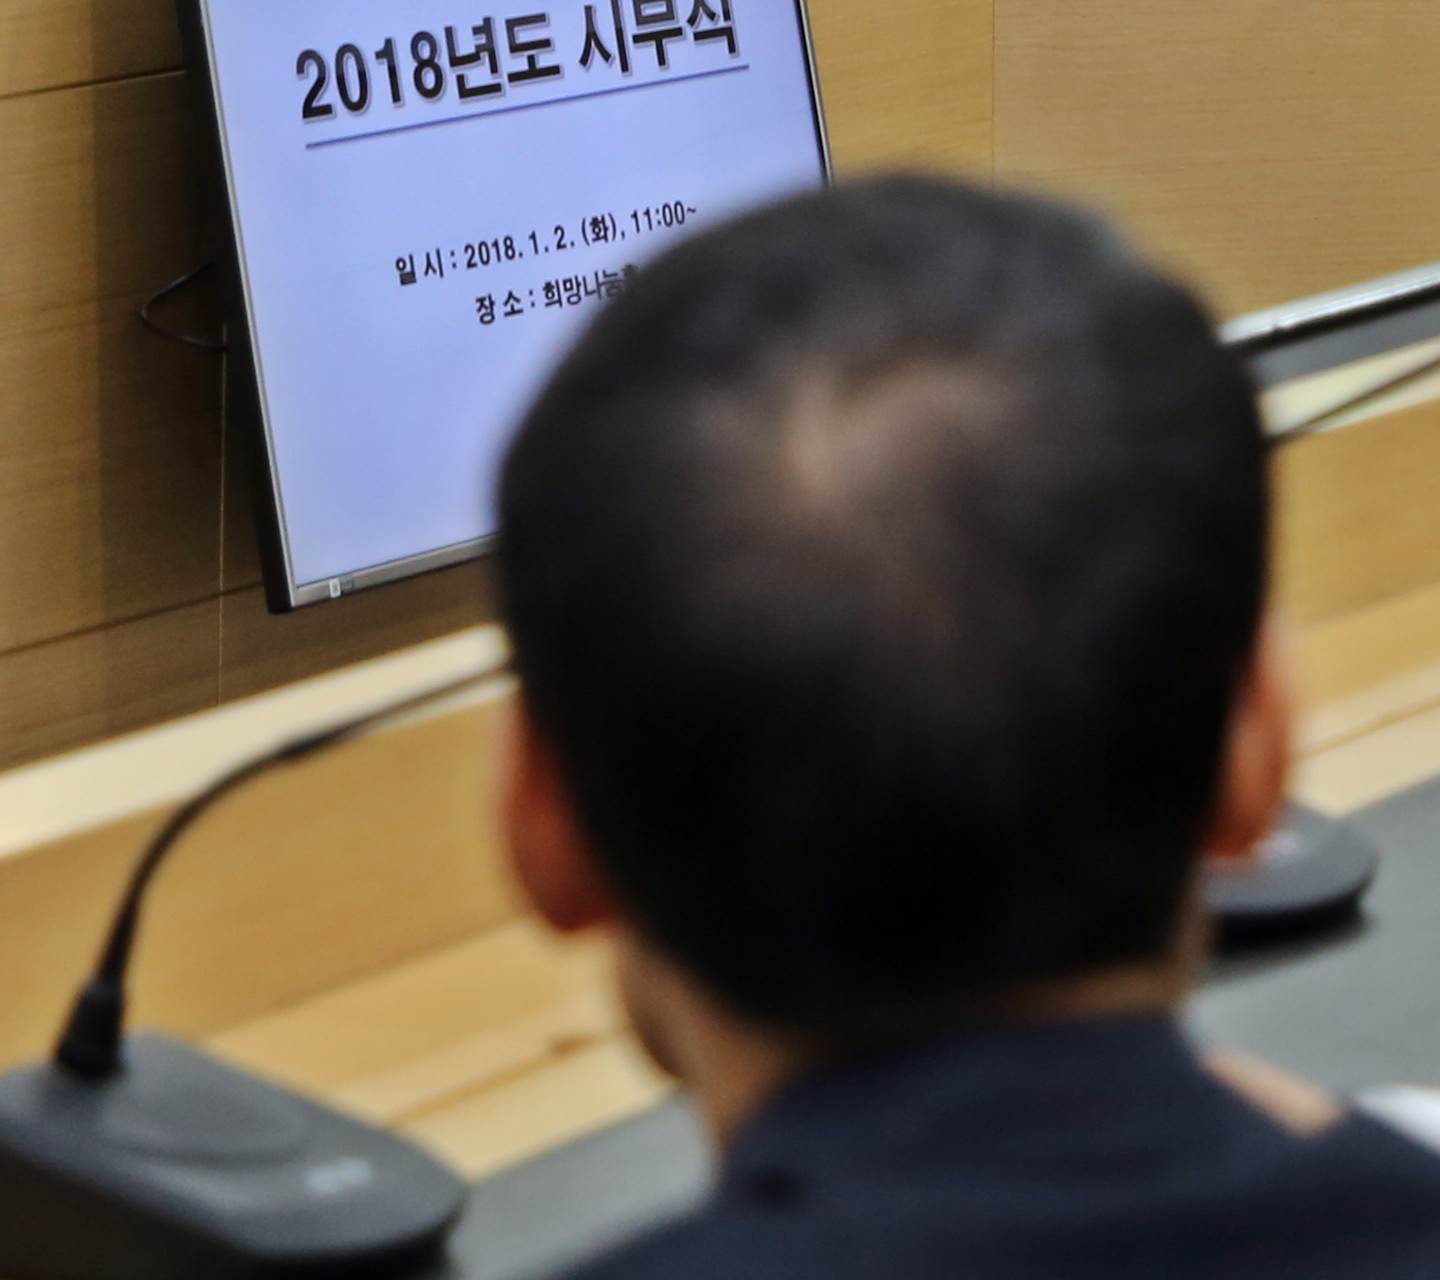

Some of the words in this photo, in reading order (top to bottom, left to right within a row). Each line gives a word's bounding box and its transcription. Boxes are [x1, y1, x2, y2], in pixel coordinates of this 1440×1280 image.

[296, 11, 564, 124] 2018년도
[464, 235, 524, 270] 2018.
[630, 200, 698, 235] 11:00~
